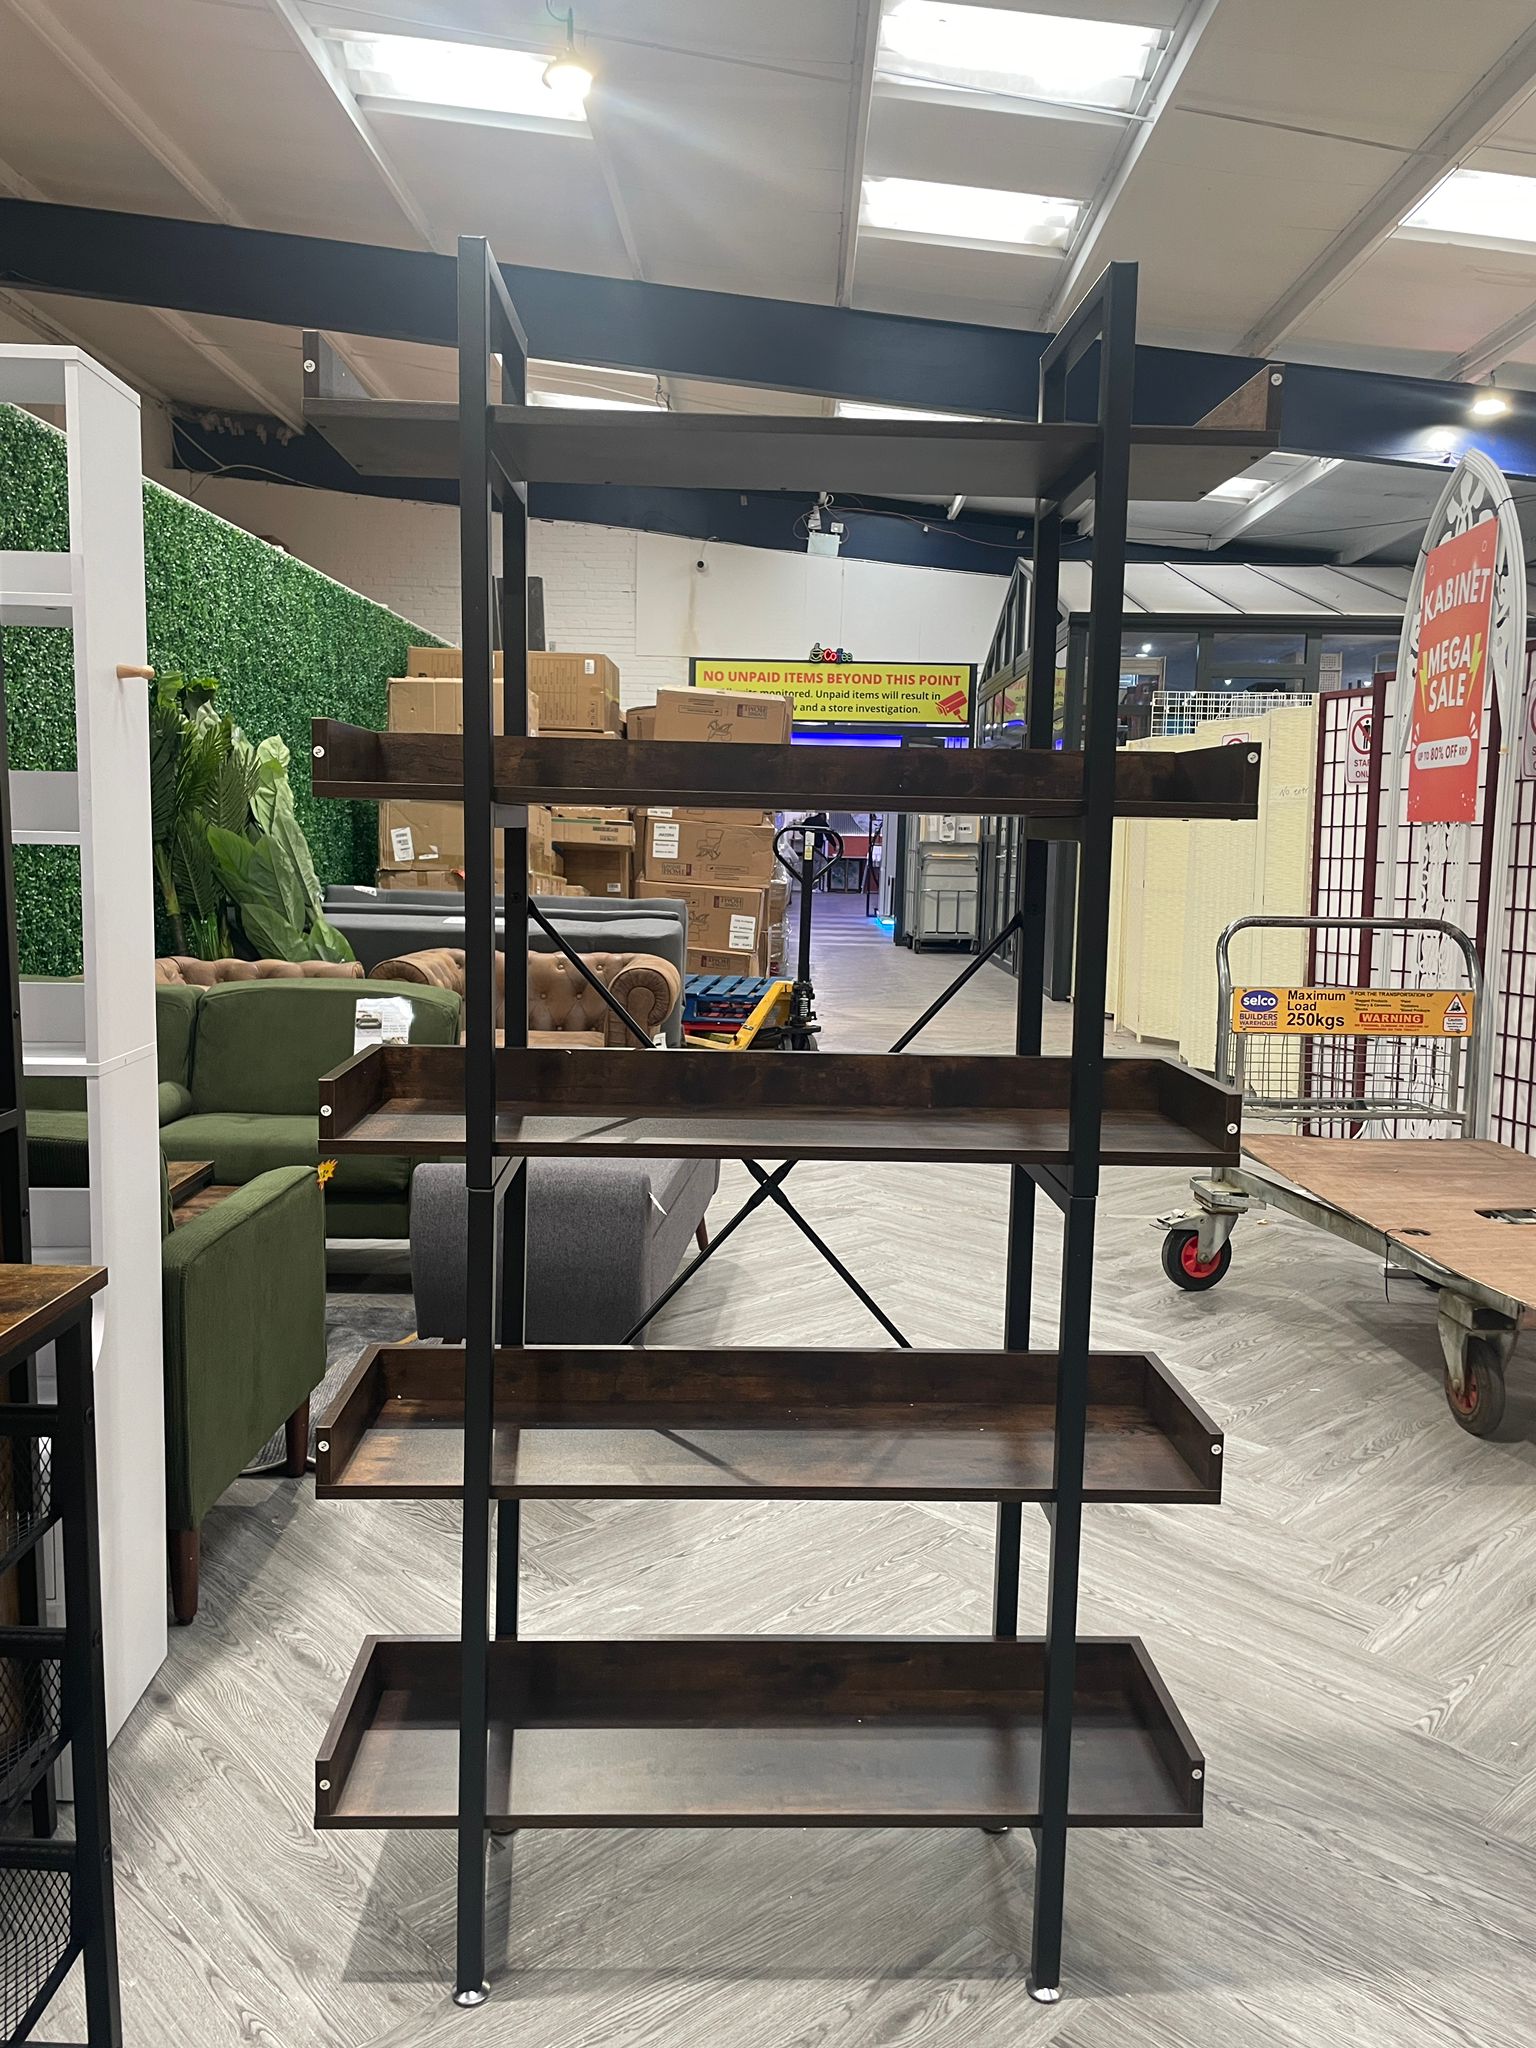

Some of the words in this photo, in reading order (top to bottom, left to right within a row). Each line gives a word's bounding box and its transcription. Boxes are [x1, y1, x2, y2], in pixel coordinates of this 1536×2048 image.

[1424, 568, 1491, 626] KABINET
[1428, 634, 1471, 679] MEGA
[703, 671, 724, 682] NO
[728, 671, 780, 682] UNPAID
[784, 672, 823, 684] ITEMS
[827, 674, 882, 684] BEYOND
[886, 674, 916, 685] THIS
[920, 675, 961, 686] POINT
[816, 690, 850, 700] Unpaid
[853, 690, 880, 698] items
[882, 690, 898, 700] will
[901, 692, 928, 700] result
[932, 692, 940, 700] in
[1428, 672, 1467, 712] SALE
[800, 704, 818, 712] and
[828, 704, 853, 712] store
[856, 704, 920, 716] investigation.
[1446, 744, 1458, 759] OFF
[1356, 770, 1370, 778] ONL
[1243, 994, 1276, 1006] selco
[1288, 990, 1346, 1001] Maximum
[1287, 1001, 1316, 1010] Load
[1287, 1013, 1344, 1030] 250kgs
[1362, 1014, 1421, 1022] WARNING
